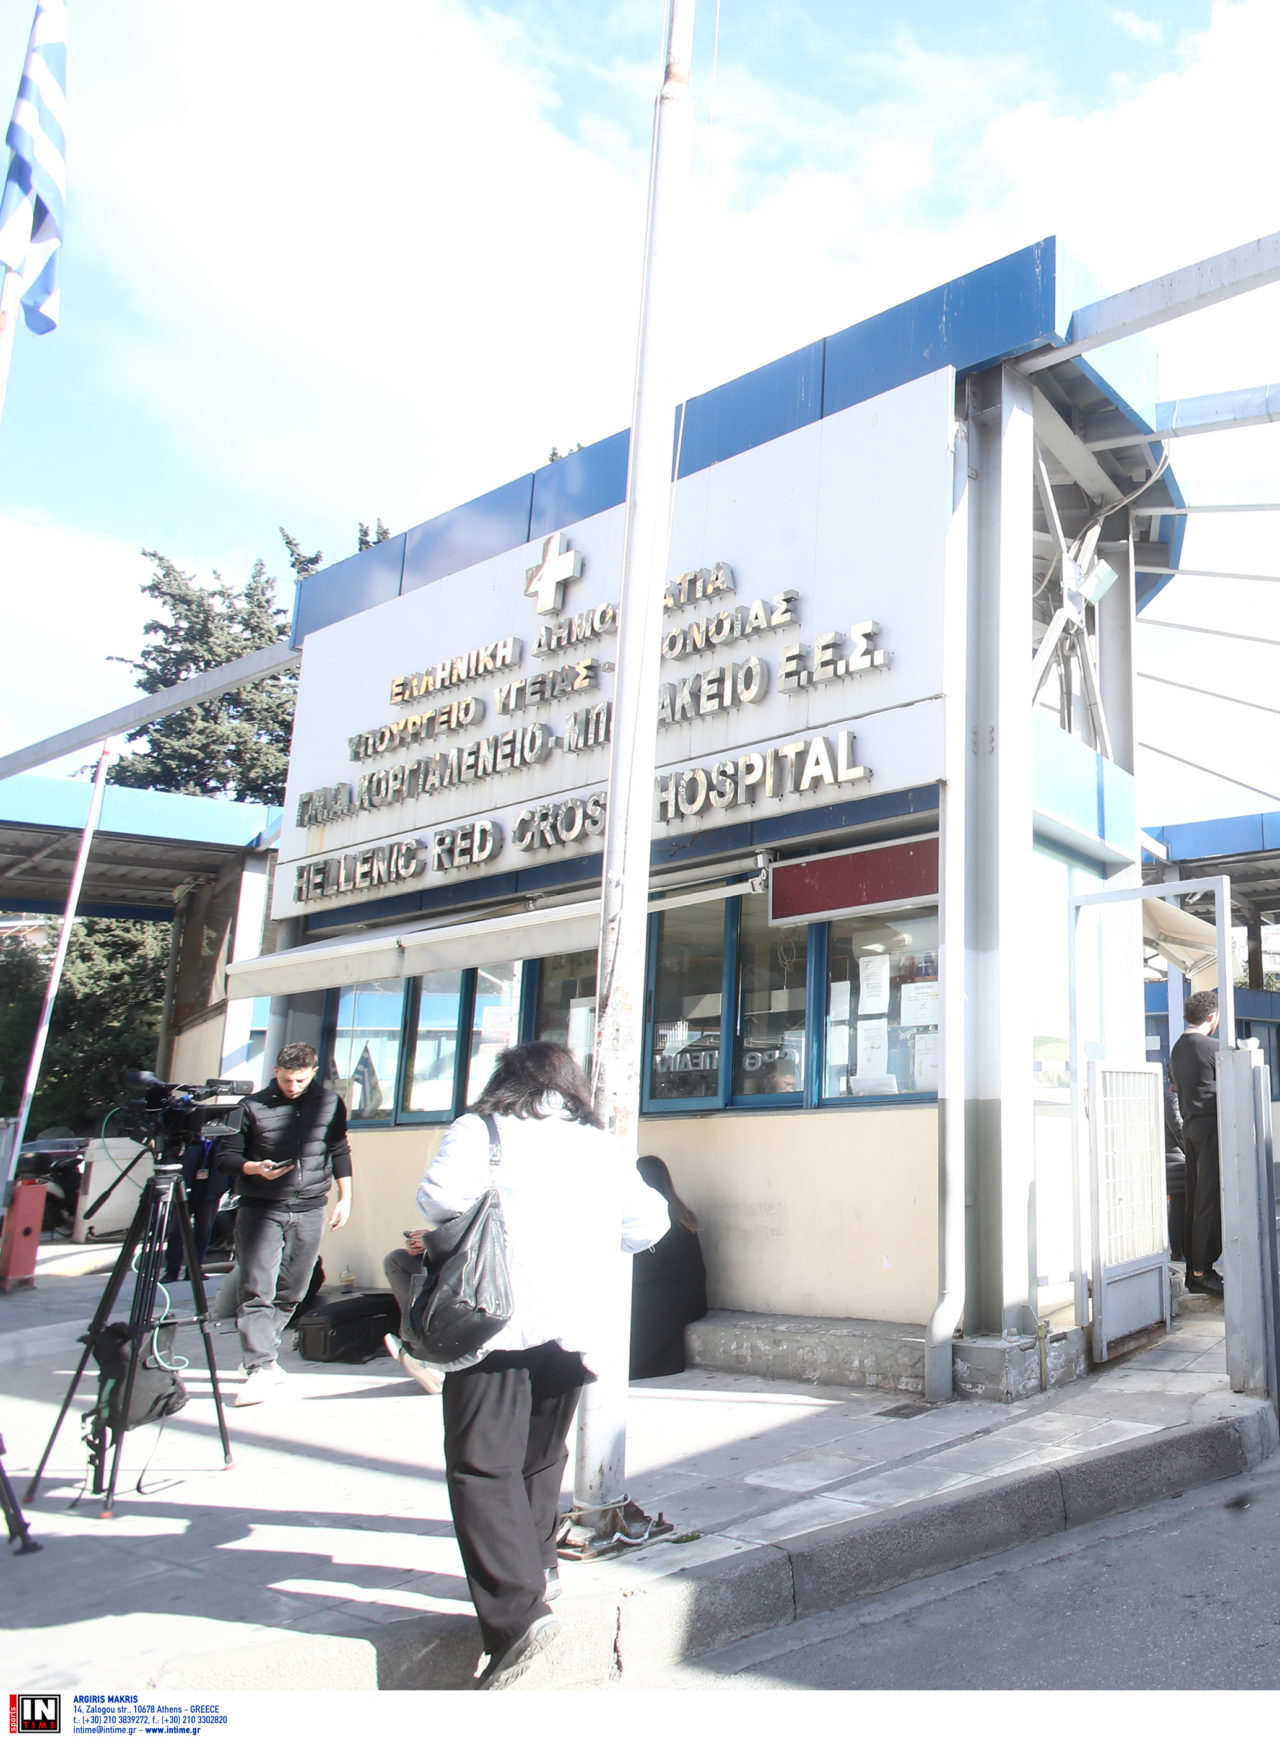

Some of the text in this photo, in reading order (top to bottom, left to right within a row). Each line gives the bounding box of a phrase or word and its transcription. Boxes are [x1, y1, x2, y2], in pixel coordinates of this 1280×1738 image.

[493, 658, 600, 715] ΥΓΕΙΑΣ
[661, 589, 799, 661] ΟΝΟΙΑΣ
[777, 620, 891, 695] Ε.Ε.Σ.
[294, 731, 873, 903] HELLENIC RED CROS HOSPITAL
